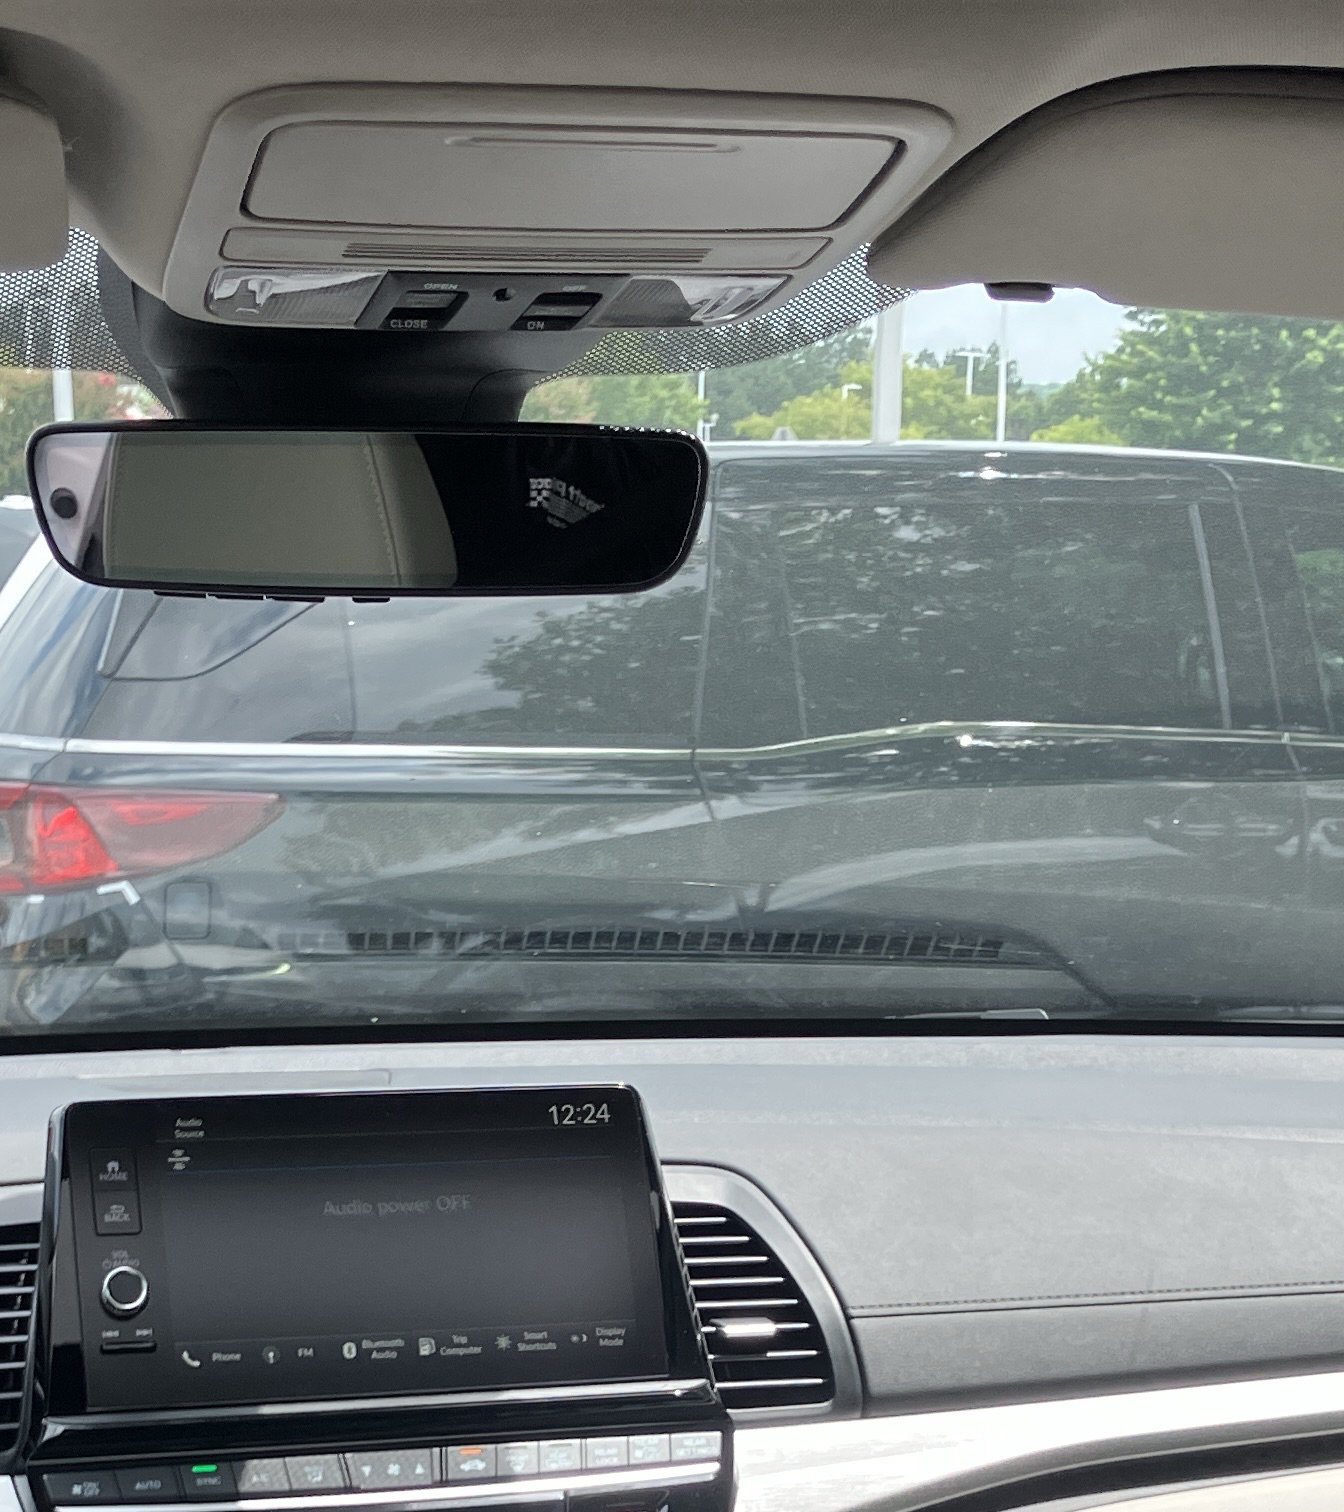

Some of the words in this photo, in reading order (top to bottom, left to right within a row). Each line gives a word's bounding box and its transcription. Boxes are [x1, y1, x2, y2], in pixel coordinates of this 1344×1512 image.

[390, 318, 428, 329] CLOSE
[527, 320, 545, 331] ON
[547, 1102, 612, 1126] 12:24
[323, 1200, 373, 1217] Audio
[378, 1201, 433, 1218] power
[436, 1194, 472, 1212] OFF
[104, 1212, 131, 1223] BACK
[599, 1337, 625, 1347] Mode
[211, 1351, 242, 1363] Phone
[298, 1347, 314, 1358] FM
[371, 1349, 398, 1360] Audio
[133, 1478, 163, 1492] AUTO
